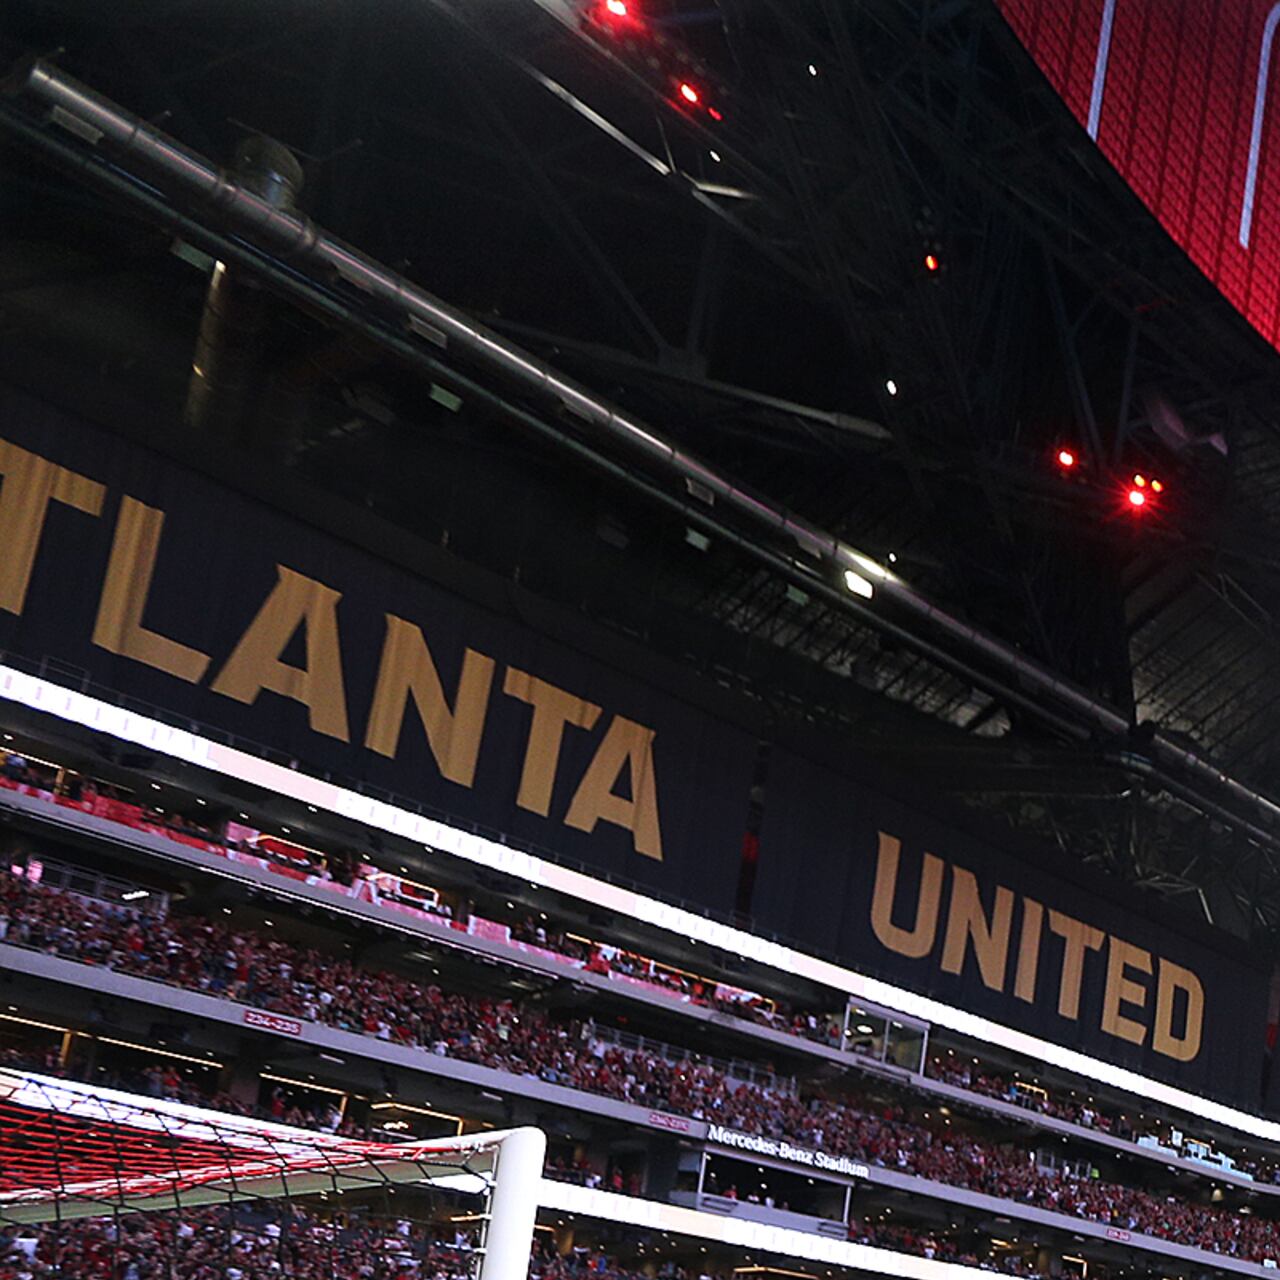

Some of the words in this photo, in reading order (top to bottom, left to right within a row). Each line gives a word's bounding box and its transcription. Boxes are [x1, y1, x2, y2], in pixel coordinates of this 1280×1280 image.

[870, 831, 1205, 1062] UNITED
[708, 1124, 814, 1165] Mercedes-Benz
[814, 1151, 870, 1178] Stadium
